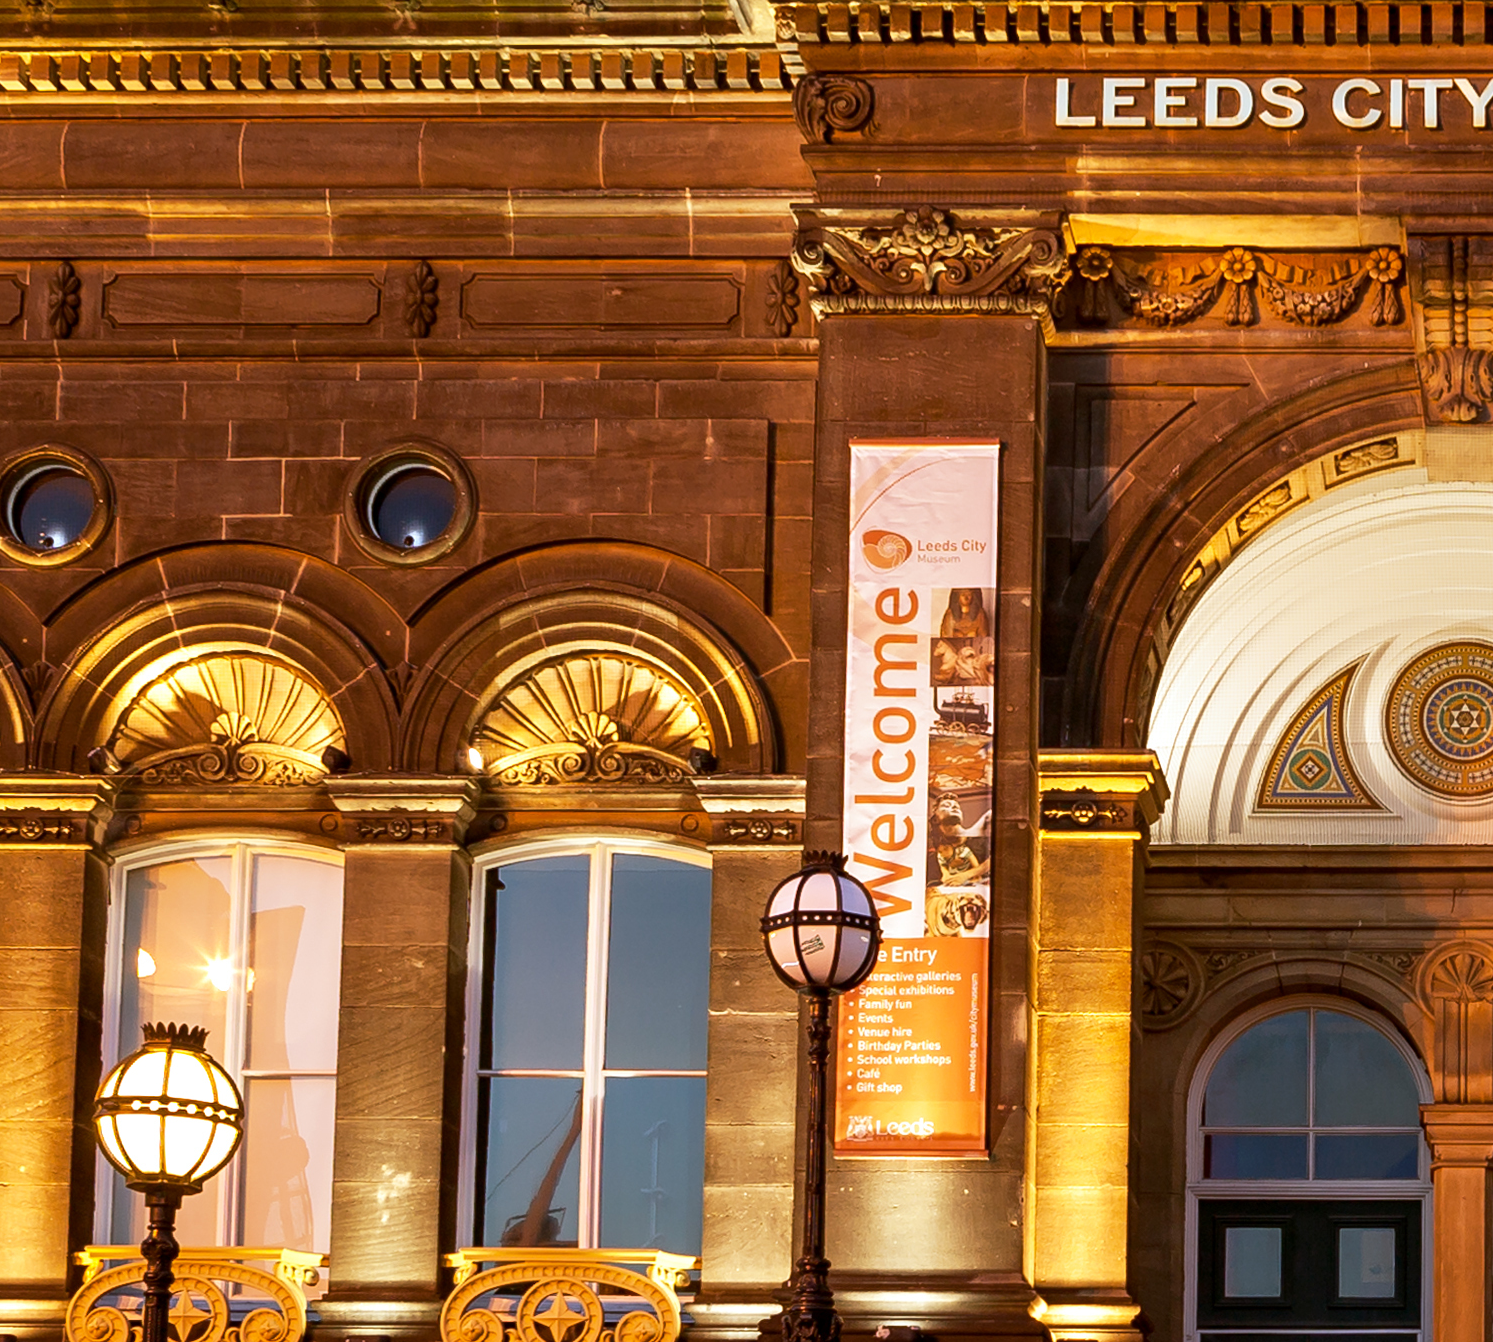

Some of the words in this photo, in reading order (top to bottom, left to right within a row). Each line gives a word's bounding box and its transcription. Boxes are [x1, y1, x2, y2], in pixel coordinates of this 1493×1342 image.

[1053, 76, 1307, 130] LEEDS
[917, 540, 958, 552] Leeds
[961, 539, 987, 554] City
[917, 554, 961, 563] Museum
[853, 587, 919, 917] Welcome
[892, 946, 937, 965] Entry
[866, 971, 914, 981] teractive
[916, 971, 961, 984] galleries
[858, 985, 897, 997] Special
[899, 985, 955, 996] exhibitions
[858, 999, 893, 1011] Family
[895, 999, 912, 1009] fun
[858, 1013, 893, 1023] Events
[858, 1027, 890, 1037] Venue
[892, 1027, 912, 1037] hire
[858, 1040, 902, 1053] Birthday
[903, 1040, 941, 1051] Parties
[857, 1054, 892, 1065] School
[894, 1054, 952, 1066] workshops
[856, 1067, 880, 1079] Café
[856, 1082, 875, 1093] Gift
[877, 1082, 903, 1095] shop
[876, 1117, 935, 1136] Leeds
